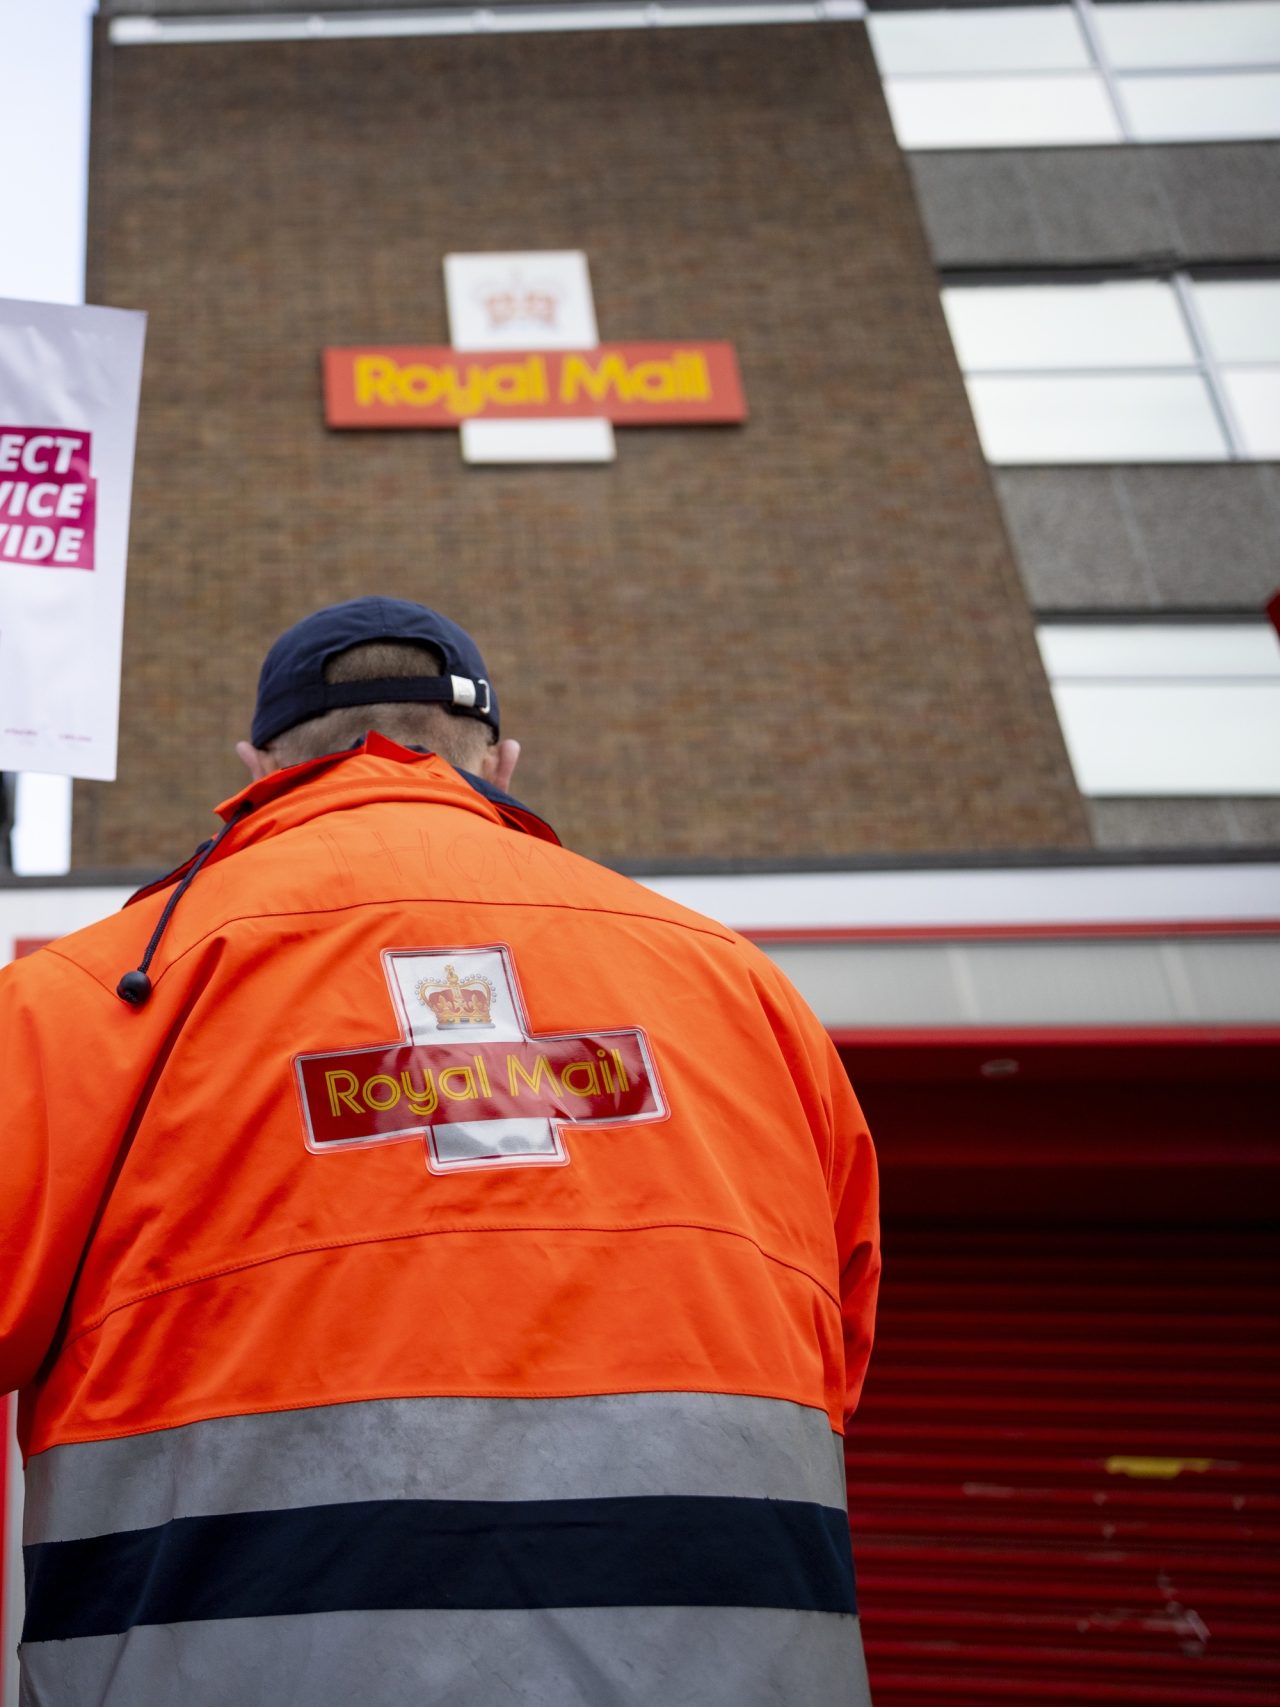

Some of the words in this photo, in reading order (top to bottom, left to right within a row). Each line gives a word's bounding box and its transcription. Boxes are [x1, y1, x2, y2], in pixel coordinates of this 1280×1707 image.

[352, 354, 549, 417] Royal
[560, 348, 713, 402] Mail
[324, 1054, 492, 1118] Royal
[506, 1047, 630, 1099] Mail
